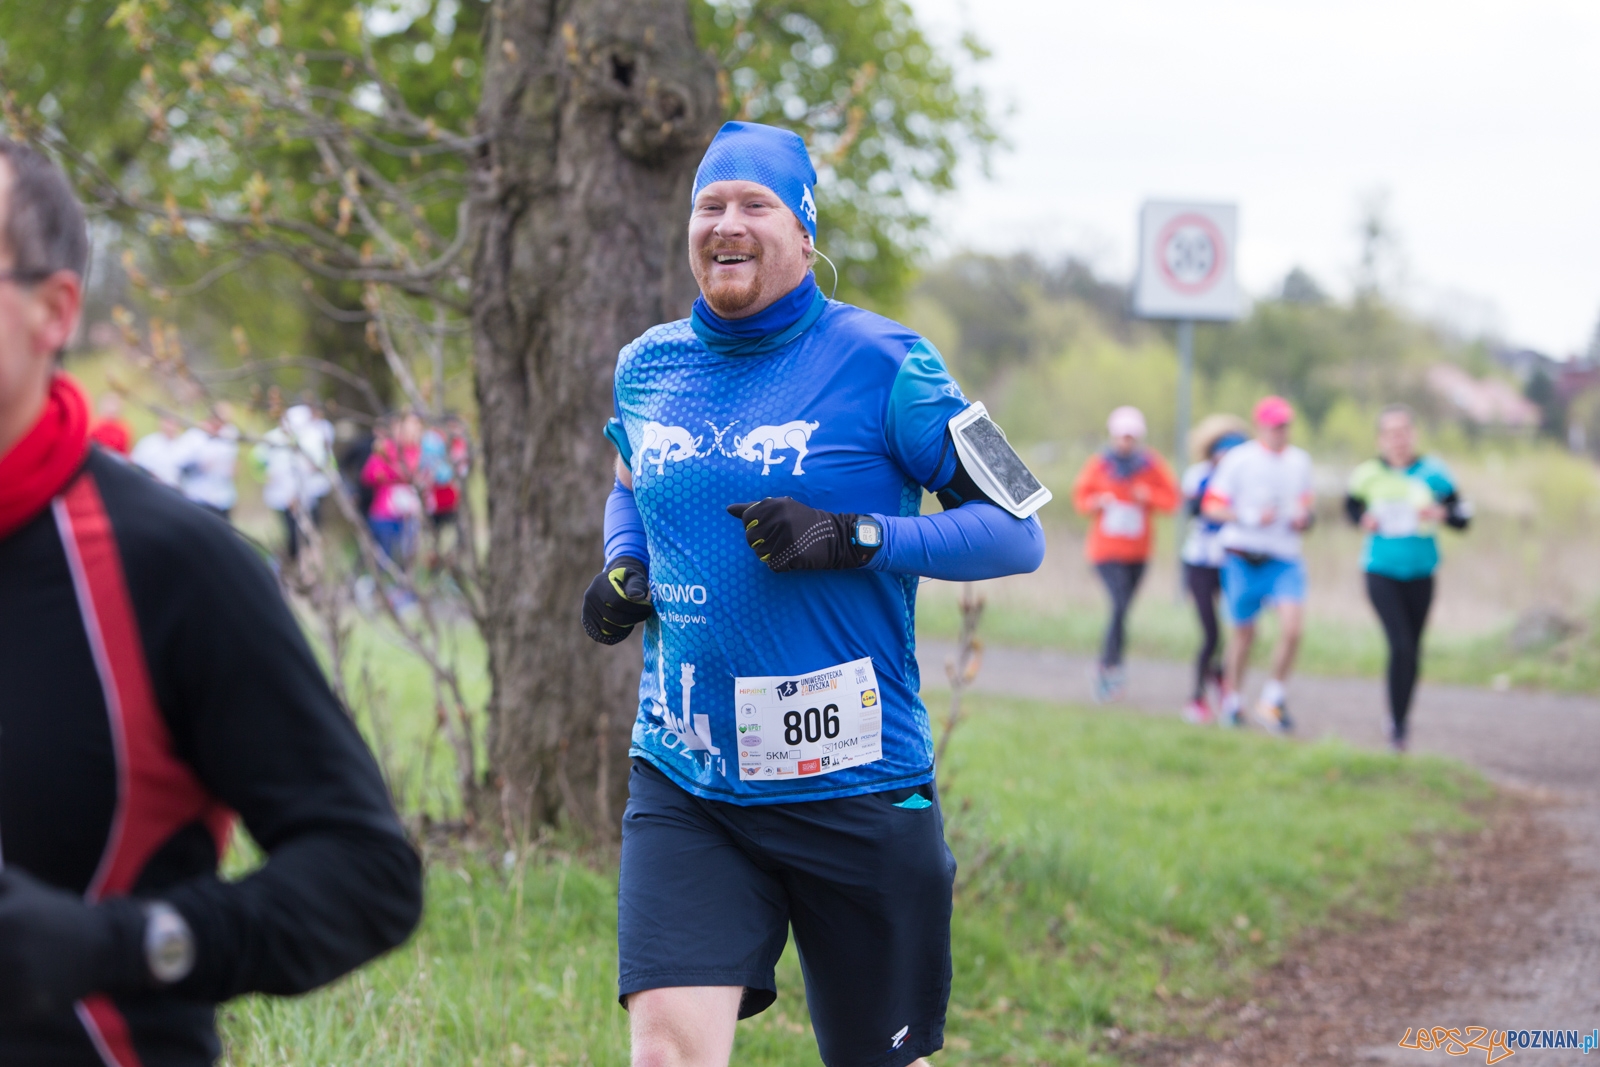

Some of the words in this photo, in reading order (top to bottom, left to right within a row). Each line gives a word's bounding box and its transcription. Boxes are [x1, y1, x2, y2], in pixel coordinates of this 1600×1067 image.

[801, 669, 843, 686] UNIWERSYTECKA
[801, 680, 830, 693] ZADYSZKA
[783, 703, 840, 746] 806
[833, 737, 858, 750] 10KM
[766, 751, 789, 760] 5KM
